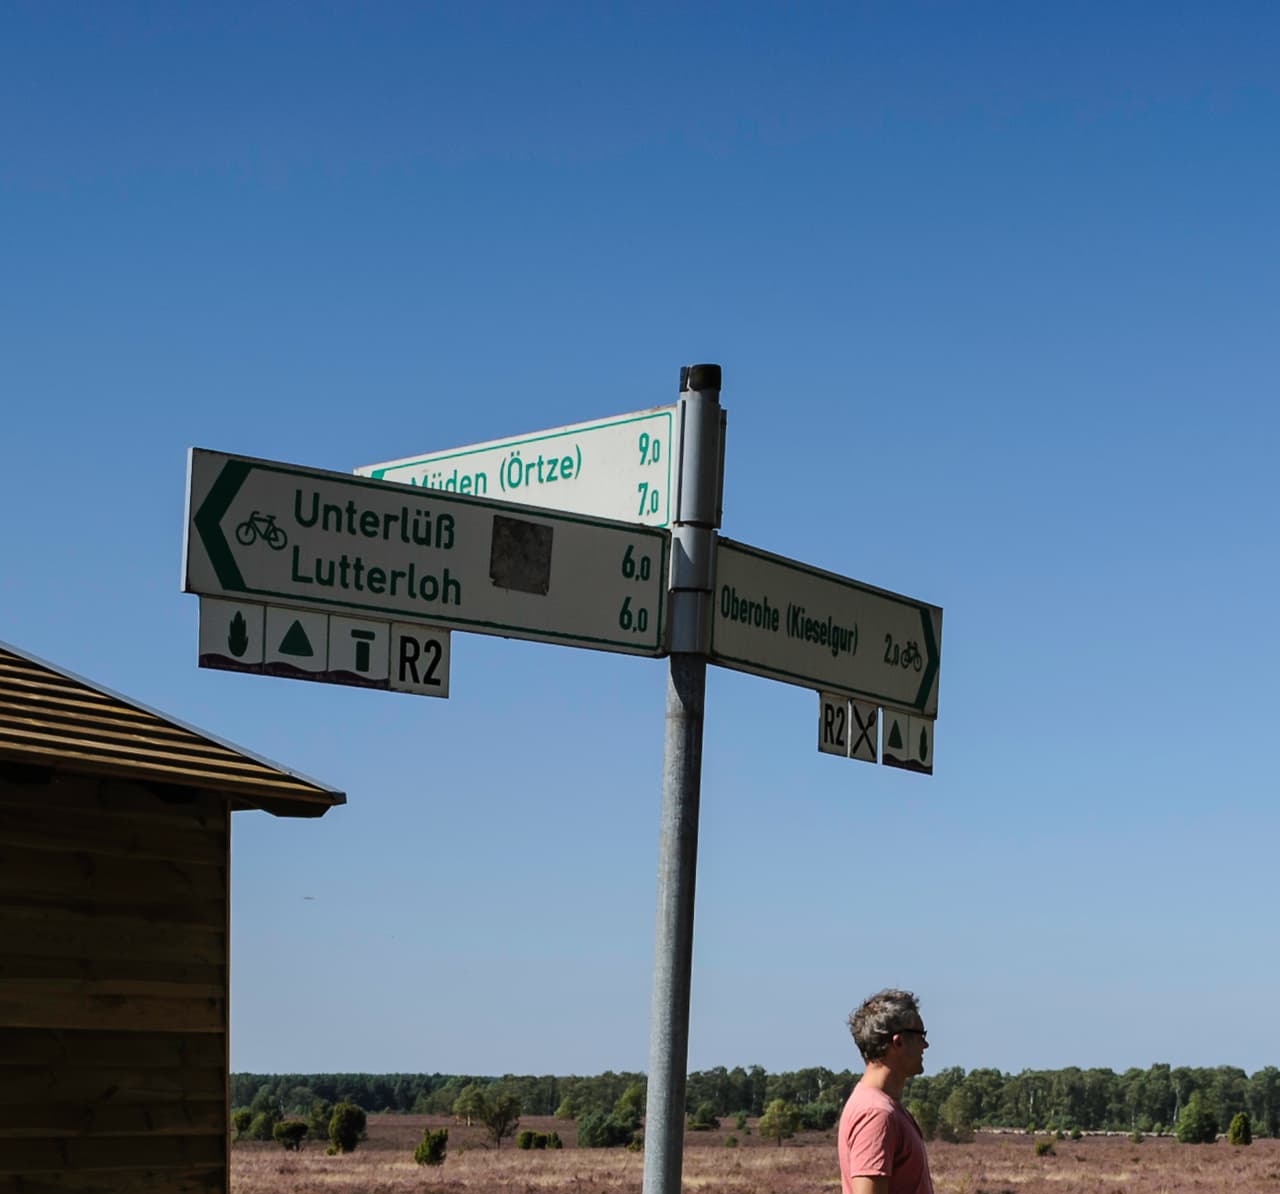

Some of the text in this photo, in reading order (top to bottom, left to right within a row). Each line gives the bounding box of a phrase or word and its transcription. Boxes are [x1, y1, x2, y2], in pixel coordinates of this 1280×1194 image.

[500, 443, 582, 492] (Örtze)
[638, 432, 660, 466] 9,0
[637, 482, 659, 516] 7,0
[294, 489, 651, 581] Unterlüß 6,0
[291, 545, 648, 632] Lutterloh 6,0
[721, 585, 900, 666] Oberohe (Kieselgur) 2,0
[398, 635, 442, 686] R2
[823, 703, 845, 746] R2
